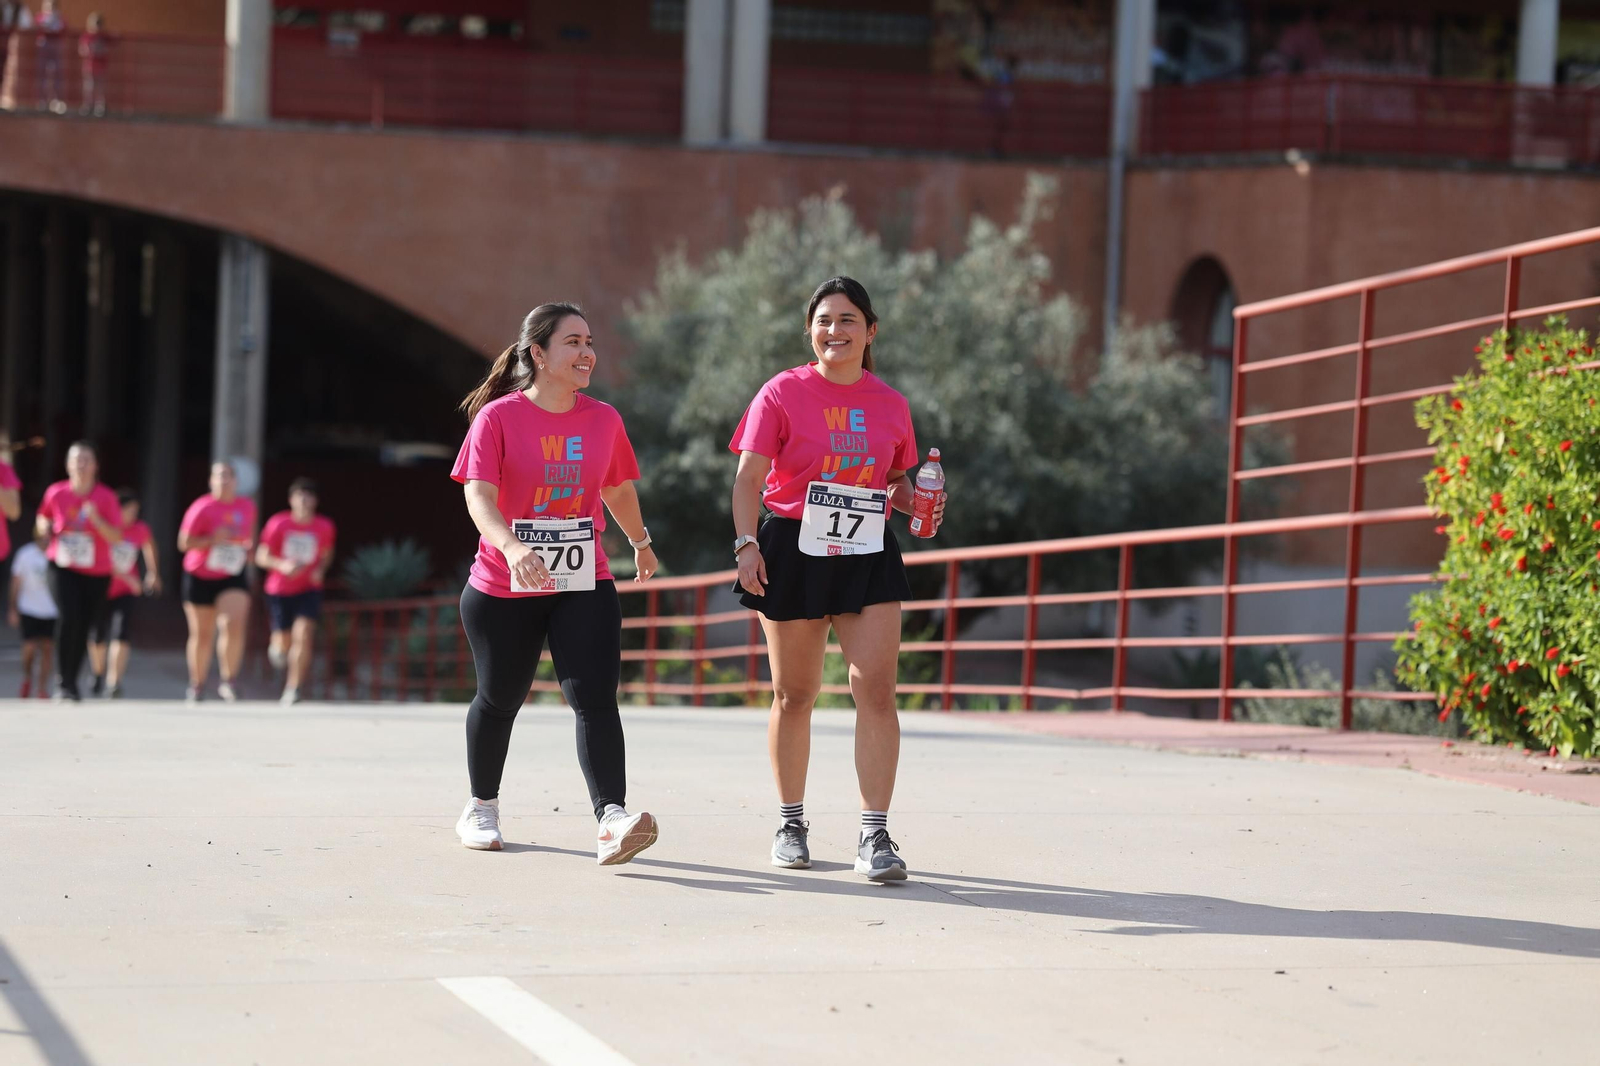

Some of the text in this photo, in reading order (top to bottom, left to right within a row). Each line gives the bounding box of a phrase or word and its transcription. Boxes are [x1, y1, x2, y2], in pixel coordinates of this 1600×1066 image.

[823, 406, 867, 432] WE
[540, 435, 583, 461] WE
[832, 434, 867, 453] RUN
[546, 465, 579, 484] RUN
[821, 455, 876, 483] UMA
[533, 487, 585, 513] UMA
[811, 492, 846, 507] UMA
[517, 531, 554, 542] UMA
[827, 511, 865, 540] 17
[828, 547, 842, 555] WE
